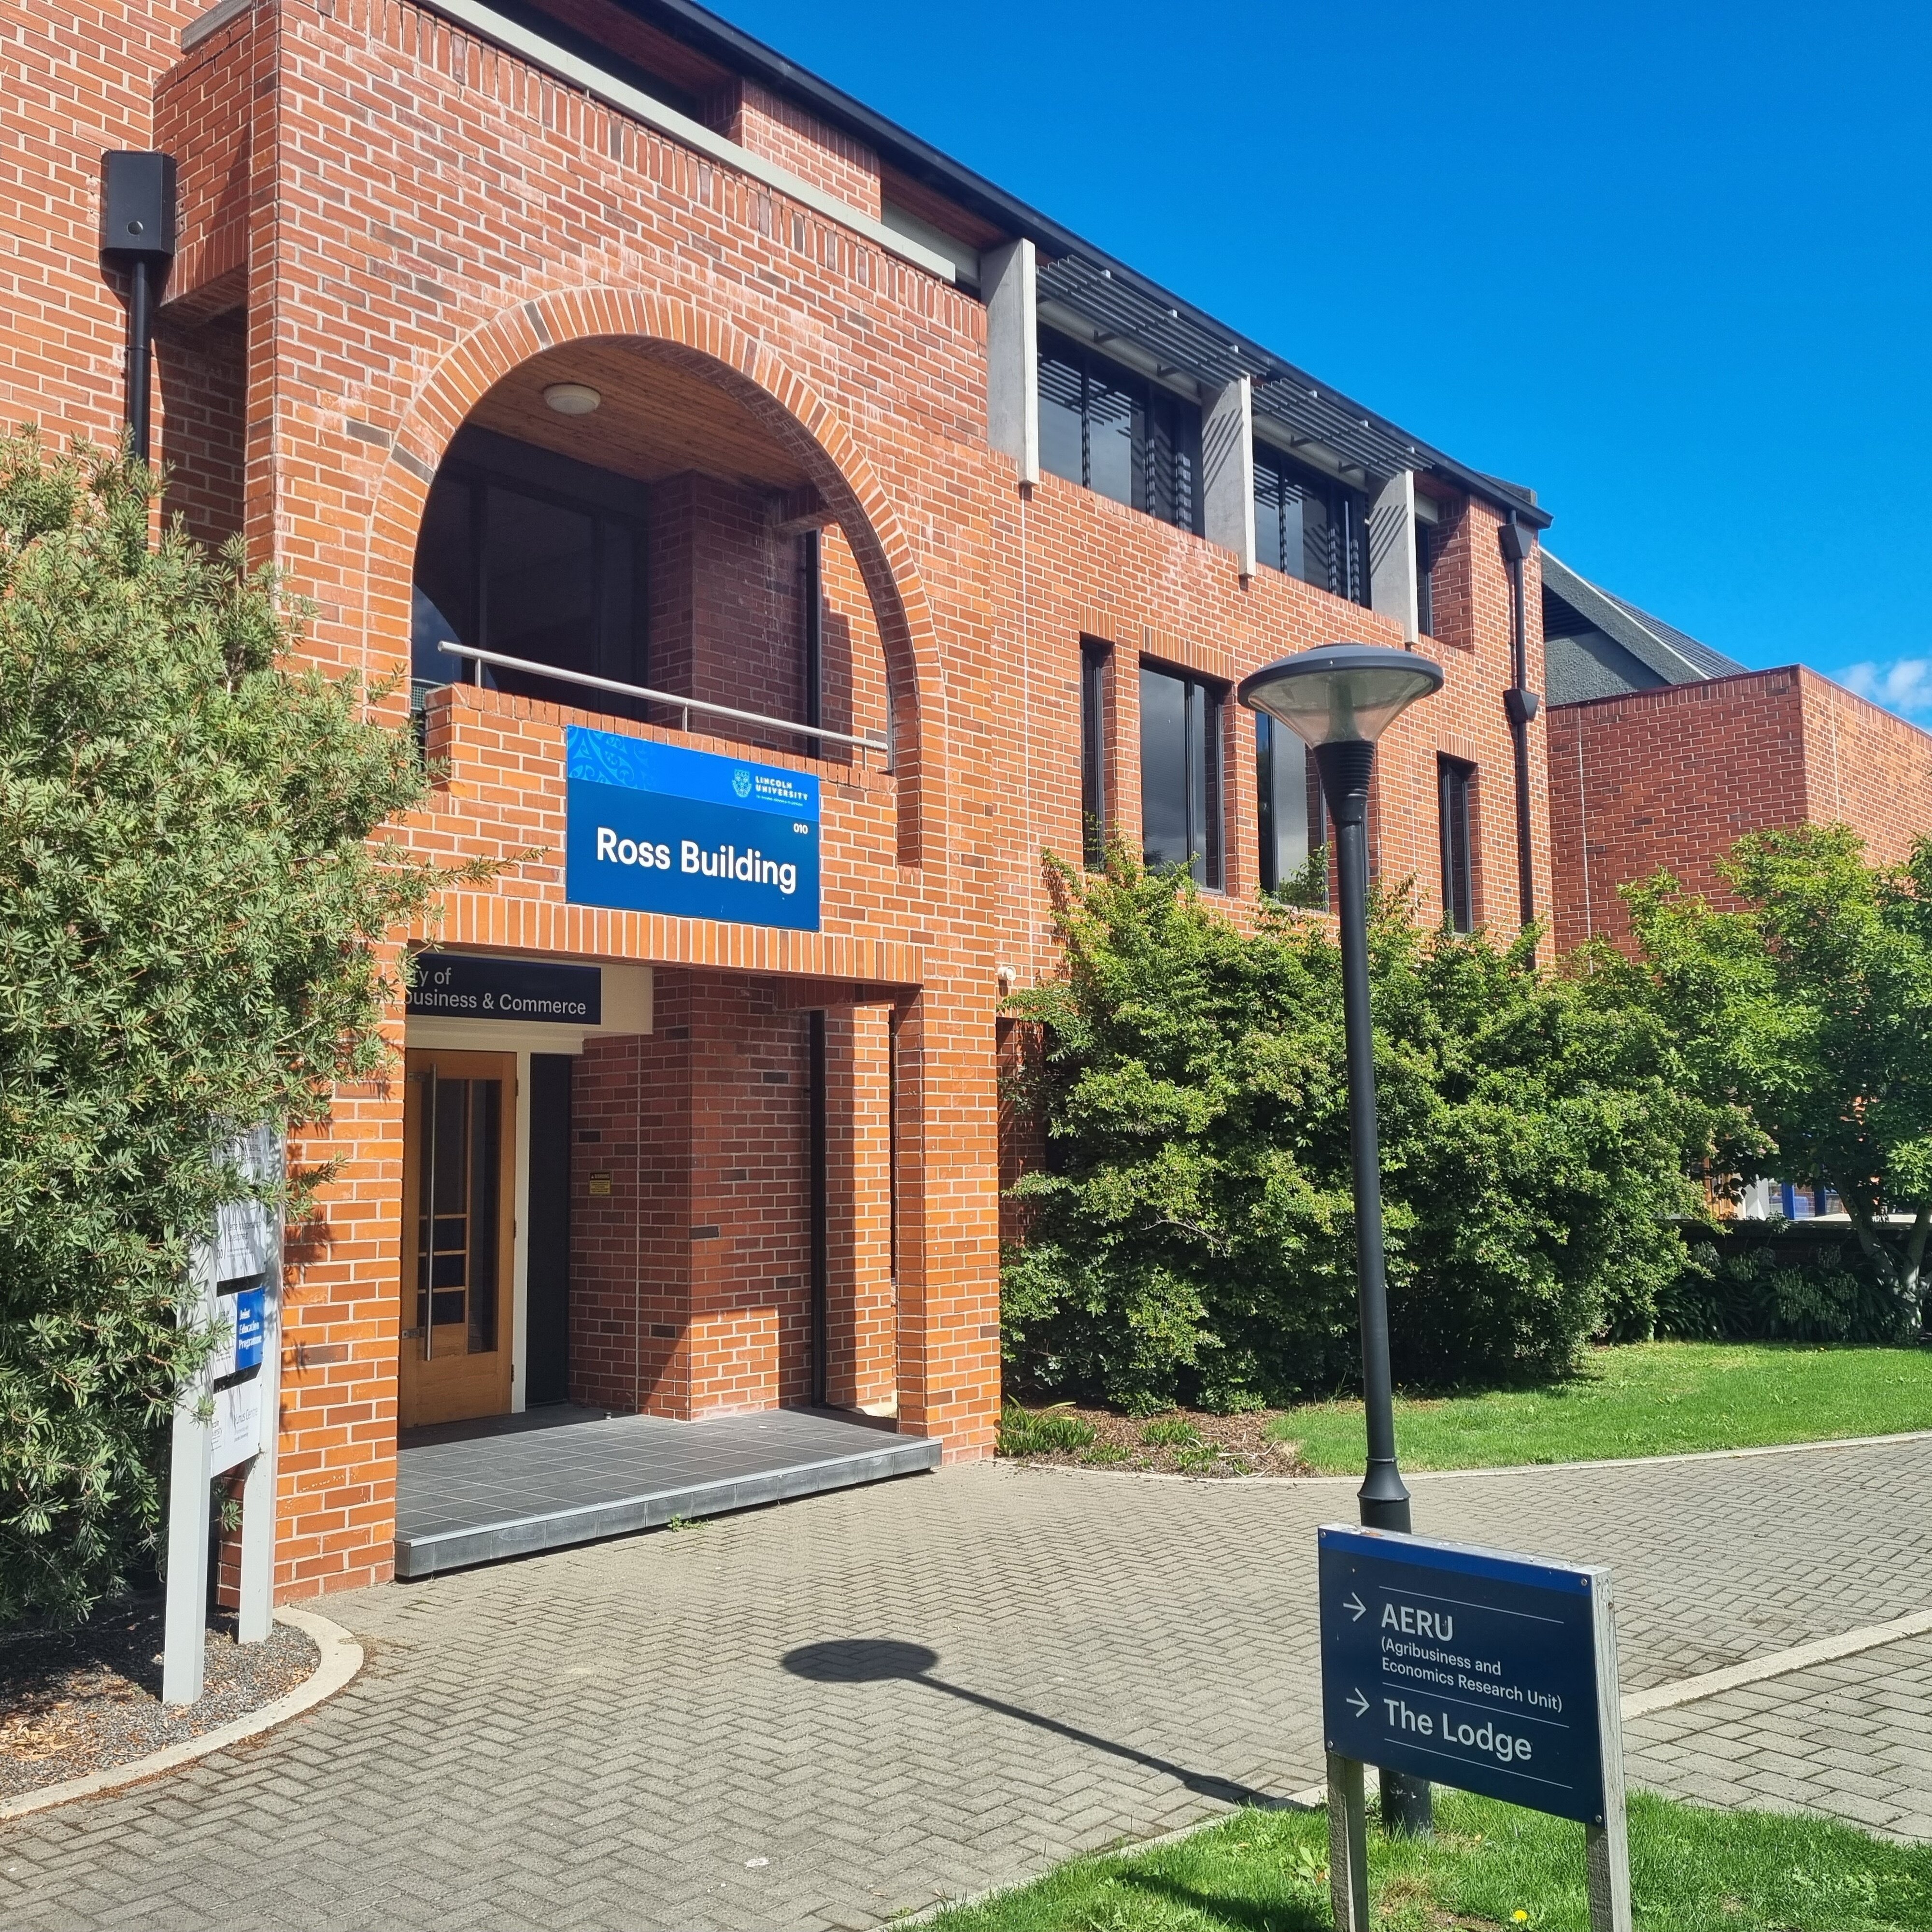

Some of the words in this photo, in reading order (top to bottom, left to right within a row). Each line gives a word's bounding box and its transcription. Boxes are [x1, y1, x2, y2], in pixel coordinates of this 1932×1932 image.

[755, 775, 793, 789] LINCOLN
[755, 783, 809, 800] UNIVERSITY
[793, 823, 808, 834] 010
[597, 827, 670, 869] Ross
[681, 840, 796, 894] Building
[434, 967, 452, 985] of
[483, 993, 494, 1009] &
[499, 994, 586, 1015] Commerce
[1381, 1603, 1453, 1641] AERU
[1381, 1636, 1471, 1669] (Agribusiness
[1475, 1661, 1501, 1676] and
[1382, 1657, 1454, 1686] Economics
[1458, 1674, 1523, 1702] Research
[1528, 1690, 1563, 1713] Unit)
[1383, 1698, 1434, 1736] The
[1443, 1713, 1533, 1762] Lodge
